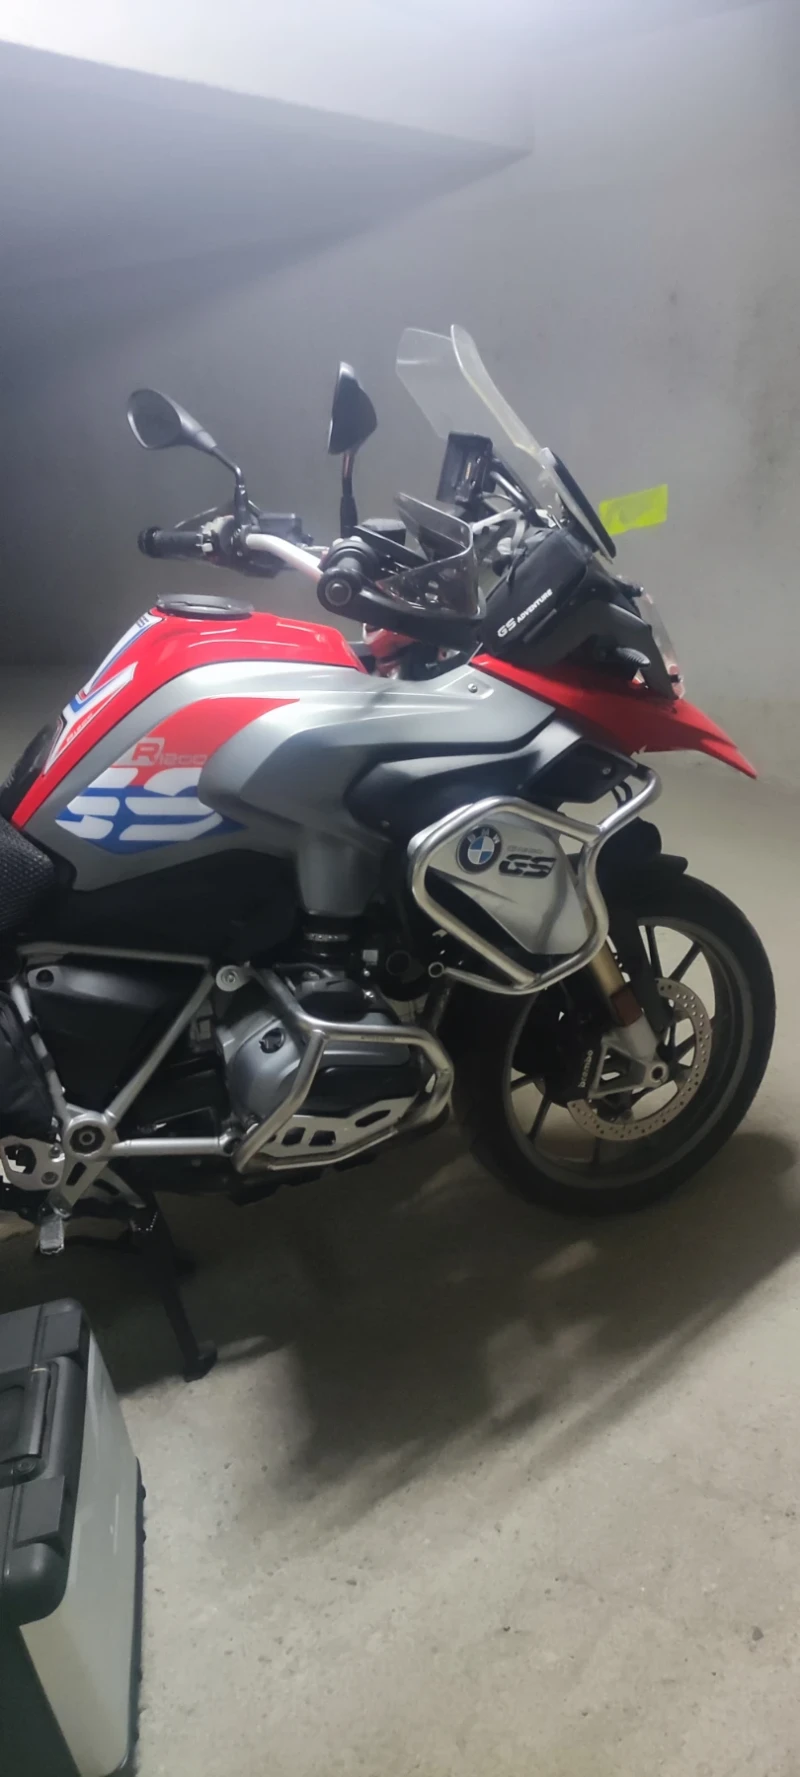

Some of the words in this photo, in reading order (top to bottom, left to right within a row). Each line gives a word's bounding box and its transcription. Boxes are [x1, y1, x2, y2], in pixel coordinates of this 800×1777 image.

[497, 617, 516, 637] GS
[517, 588, 553, 623] ADVENTURE
[499, 853, 556, 879] GS
[577, 1050, 594, 1088] brembo
